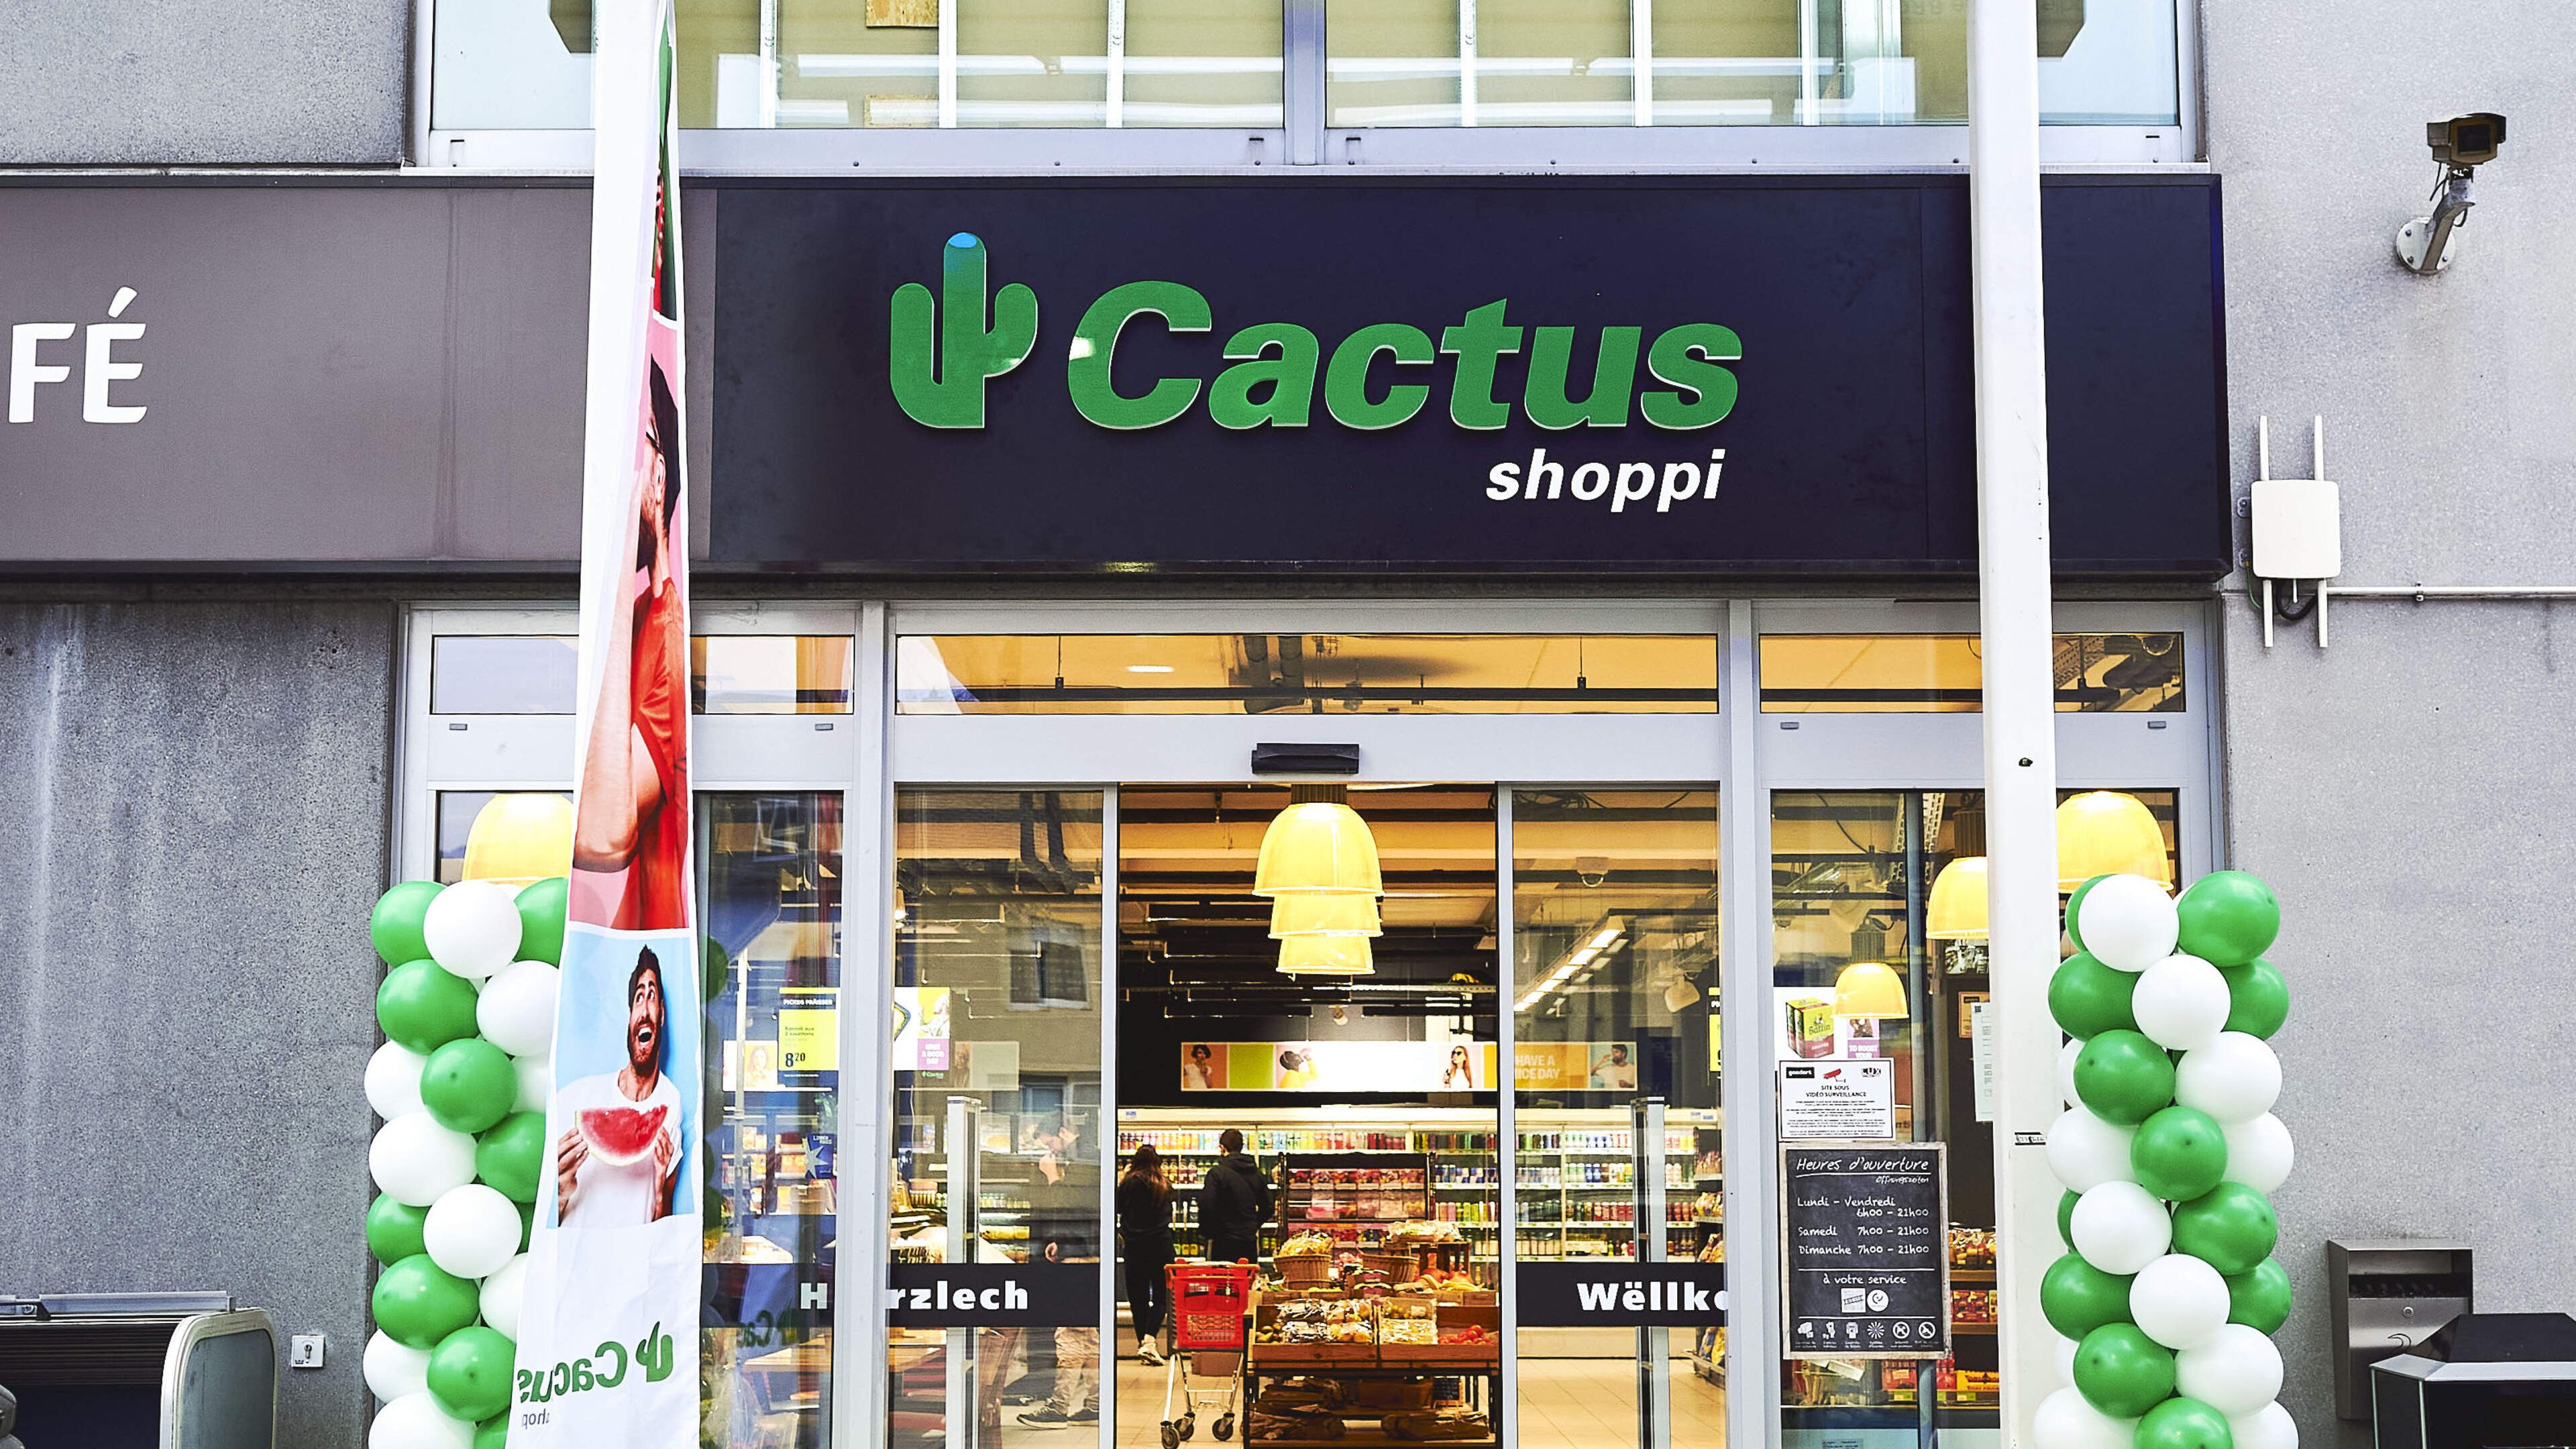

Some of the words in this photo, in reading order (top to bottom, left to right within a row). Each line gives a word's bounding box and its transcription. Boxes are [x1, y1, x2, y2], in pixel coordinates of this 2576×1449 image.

[9, 286, 147, 423] FÉ
[1068, 280, 1742, 431] Cactus
[1487, 449, 1726, 512] shoppi
[1547, 1055, 1556, 1066] A
[1538, 1068, 1560, 1079] DAY
[1796, 1158, 1842, 1171] Heures
[1849, 1157, 1929, 1172] d'ouverture
[1797, 1196, 1829, 1206] Lundi
[1844, 1196, 1896, 1206] Vendredi
[1856, 1208, 1883, 1217] 6h00
[1897, 1208, 1929, 1217] 21h00
[1798, 1226, 1838, 1236] Samedi
[1857, 1226, 1883, 1236] 7h00
[1897, 1226, 1929, 1235] 21h00
[1799, 1245, 1852, 1255] Dimanche
[1857, 1245, 1883, 1254] 7h00
[1898, 1245, 1929, 1254] 21h00
[1823, 1273, 1831, 1284] à
[1834, 1274, 1864, 1284] votre
[1868, 1275, 1907, 1284] service
[800, 1281, 1028, 1309] Hrzlech
